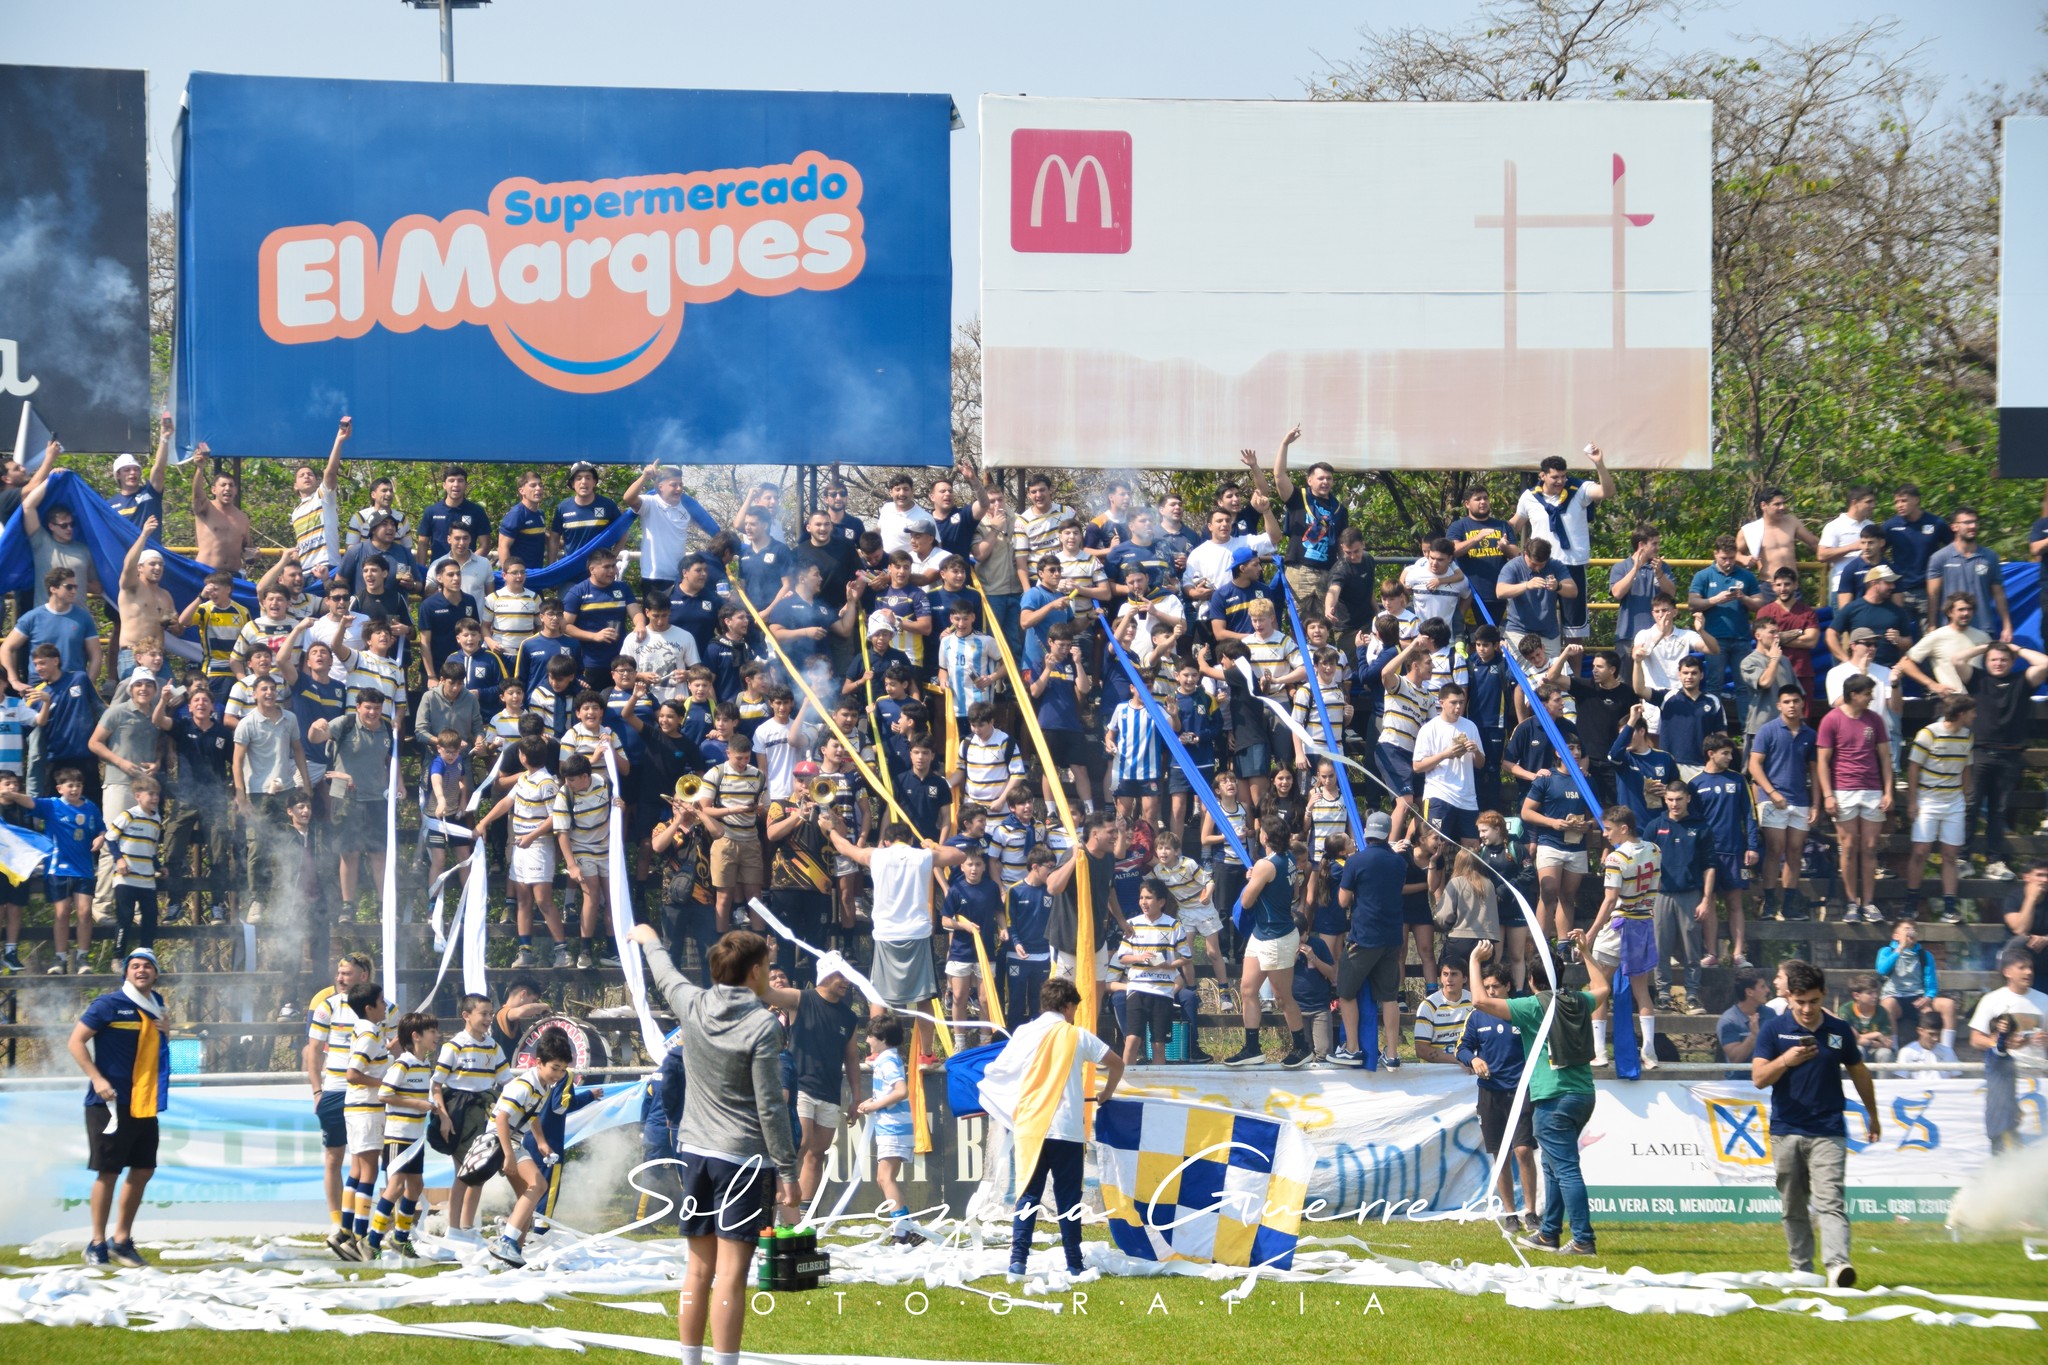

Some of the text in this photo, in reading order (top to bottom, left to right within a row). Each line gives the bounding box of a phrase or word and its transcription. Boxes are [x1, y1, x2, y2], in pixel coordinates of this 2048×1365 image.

[504, 163, 848, 233] Supermercado
[276, 212, 853, 326] El Marques
[1565, 791, 1579, 799] USA
[1618, 1197, 1649, 1213] VERA
[1652, 1197, 1677, 1215] ESQ.
[1680, 1197, 1736, 1214] MENDOZA
